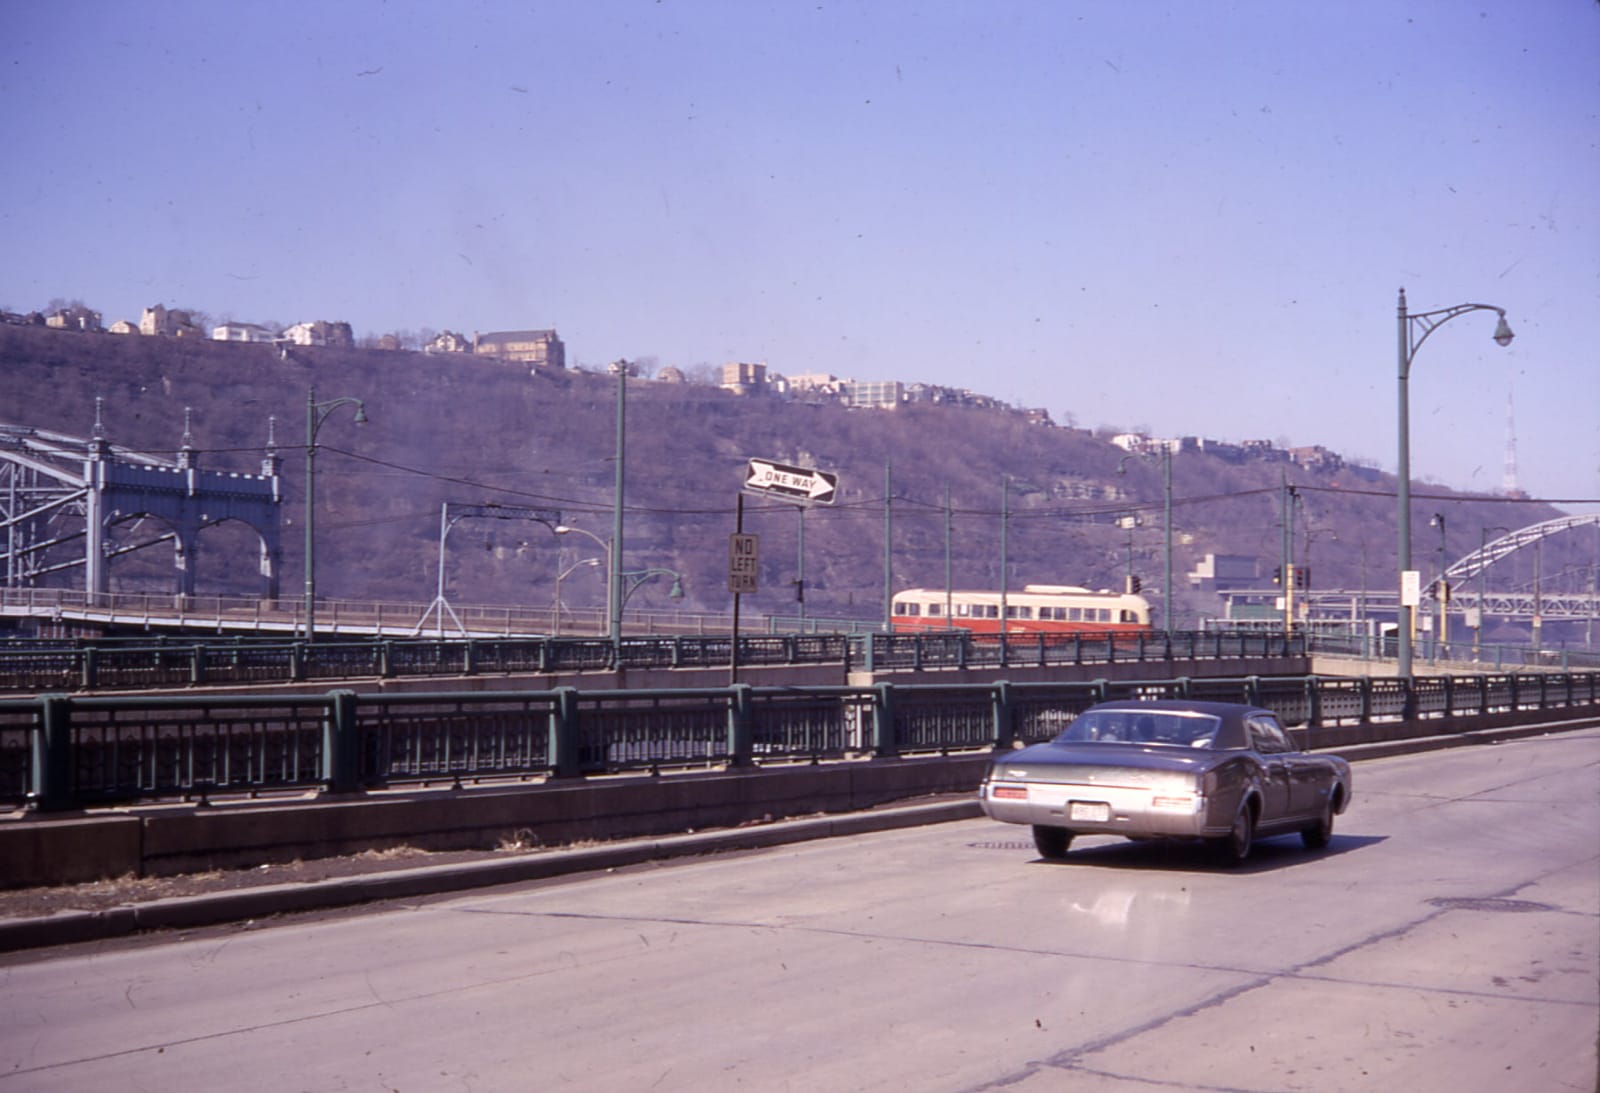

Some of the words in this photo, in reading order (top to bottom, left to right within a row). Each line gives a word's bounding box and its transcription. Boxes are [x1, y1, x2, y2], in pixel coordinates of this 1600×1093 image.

[765, 471, 788, 485] ONE
[791, 476, 817, 489] WAY
[734, 538, 753, 555] NO
[731, 557, 756, 572] LEFT
[730, 574, 756, 588] TURN
